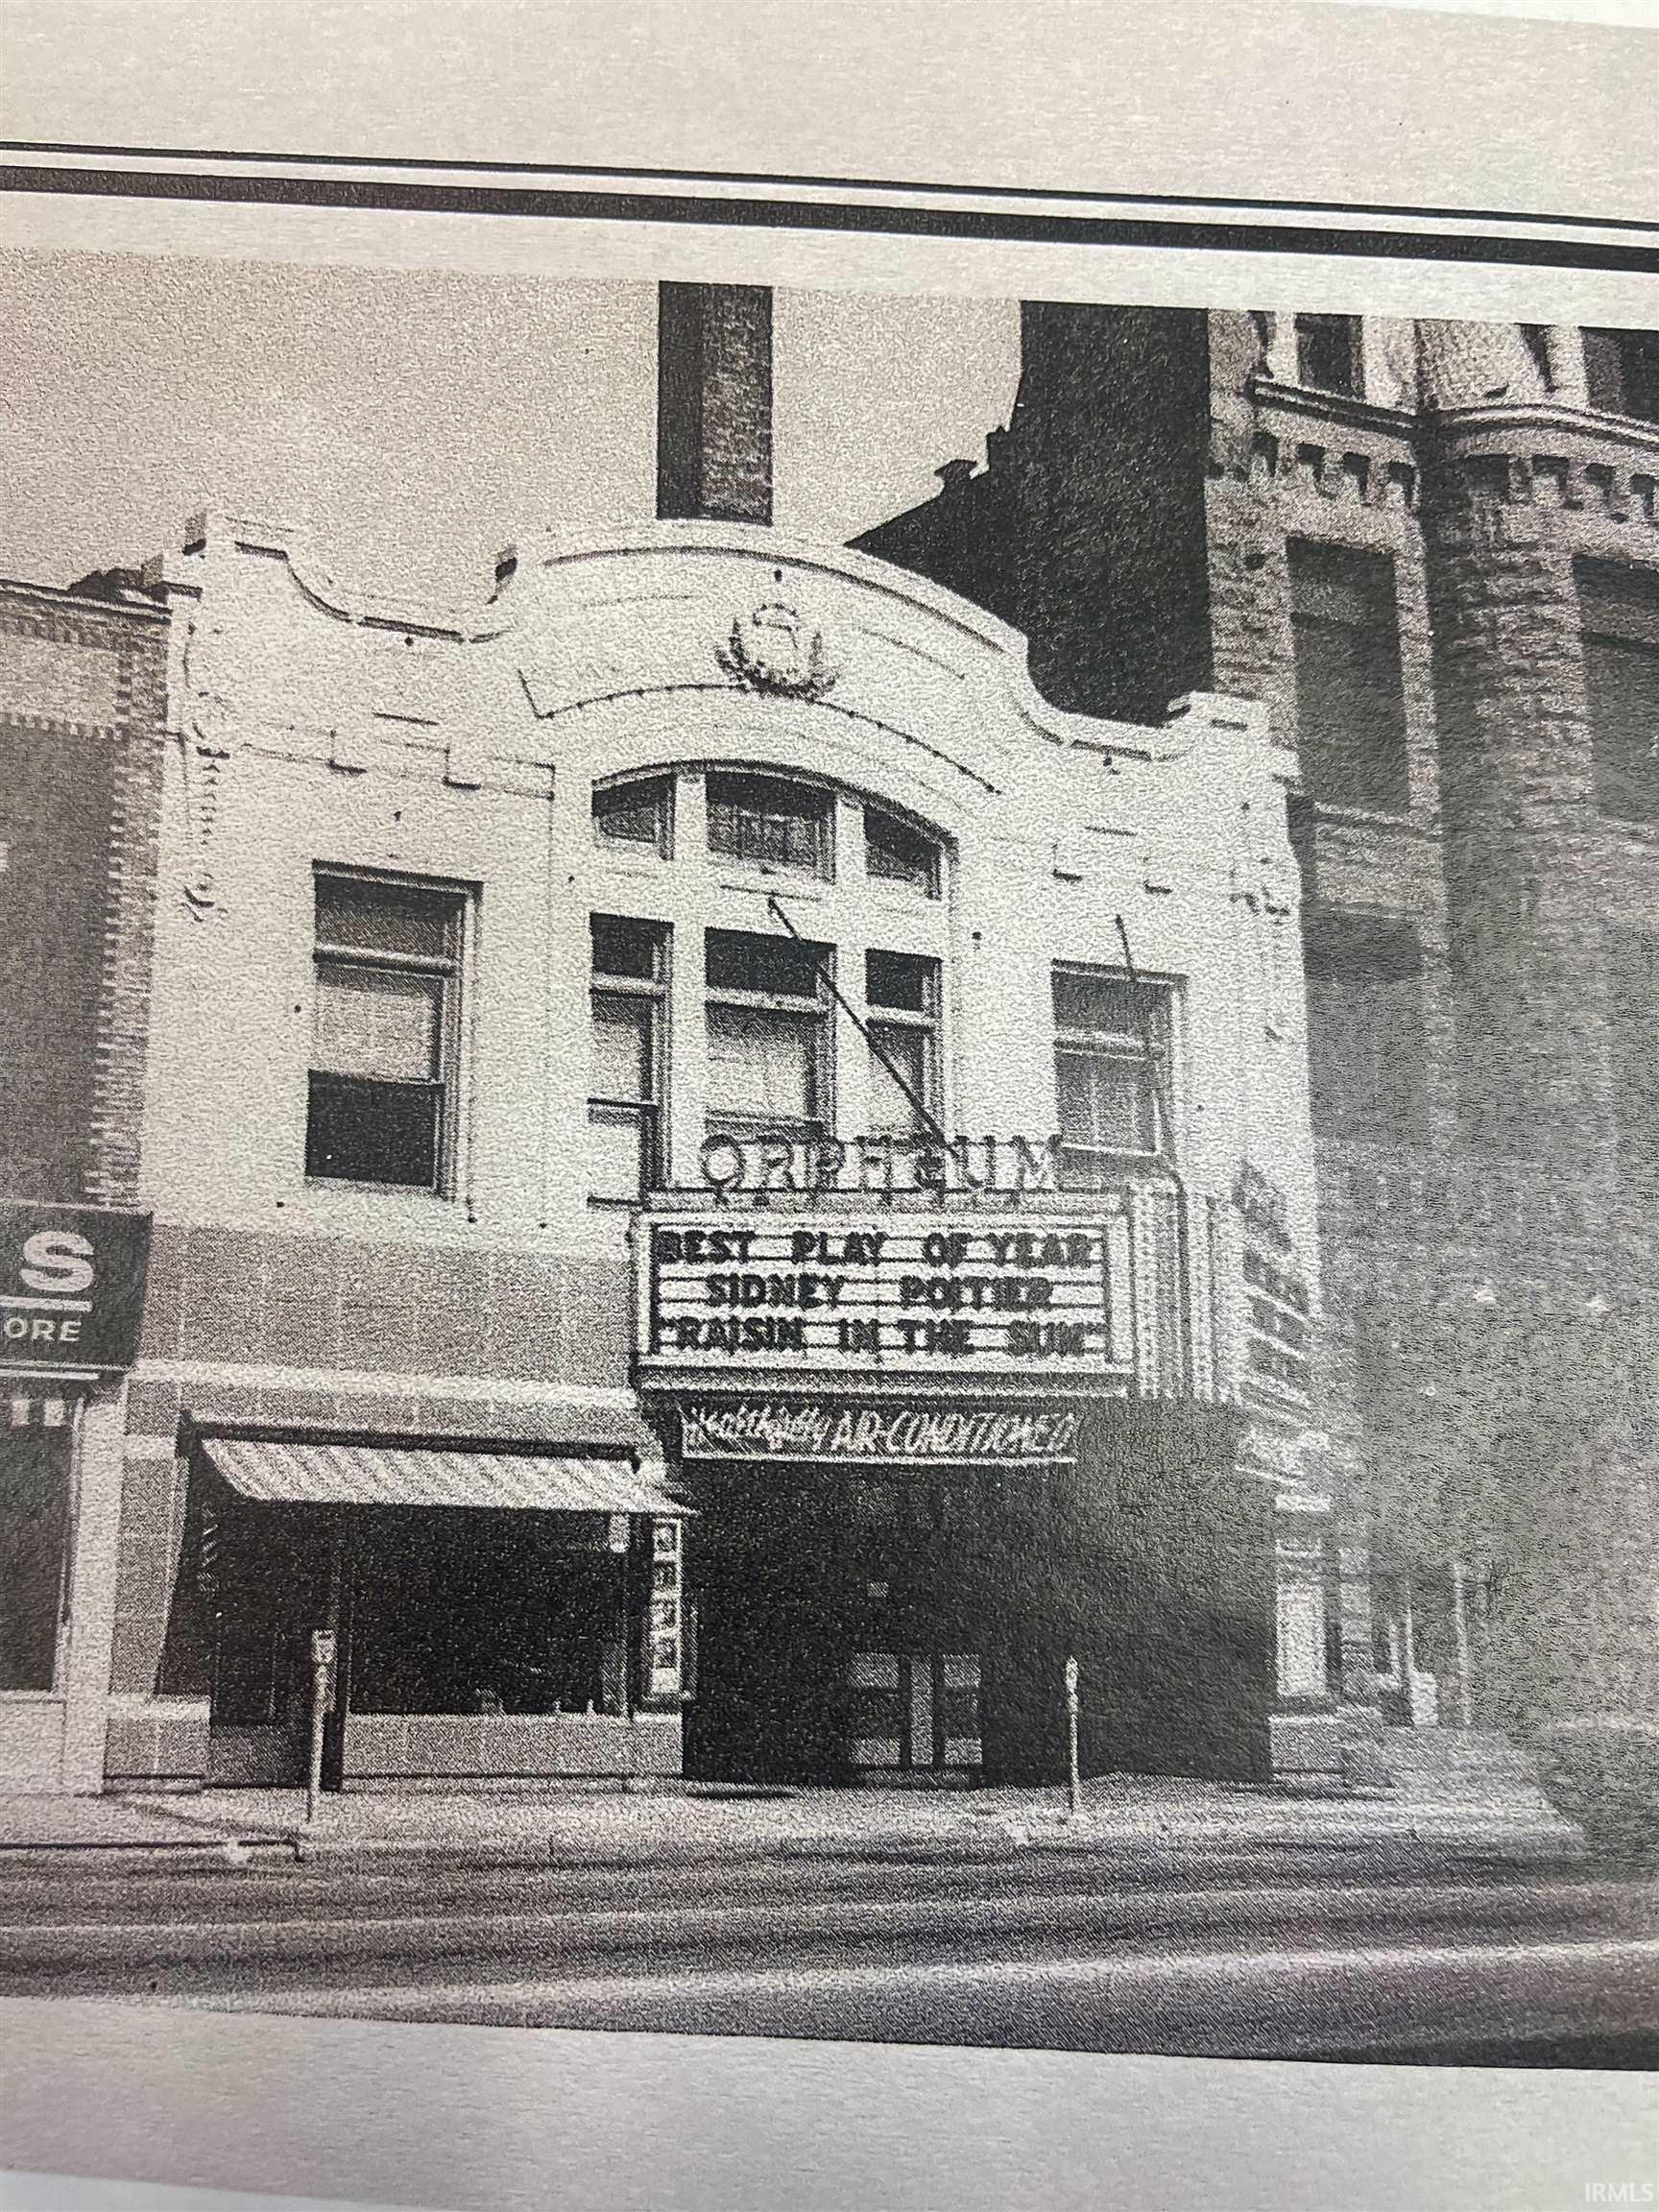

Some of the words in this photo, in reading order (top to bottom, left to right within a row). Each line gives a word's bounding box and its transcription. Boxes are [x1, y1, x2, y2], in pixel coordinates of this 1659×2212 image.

[700, 1134, 1063, 1192] ORPHEUM
[658, 1230, 757, 1264] BEST
[791, 1231, 887, 1266] PLAY
[923, 1233, 973, 1267] OF
[986, 1233, 1094, 1269] YEAR
[706, 1272, 846, 1310] SIDNEY
[839, 1319, 880, 1355] IN
[897, 1319, 975, 1356] THE
